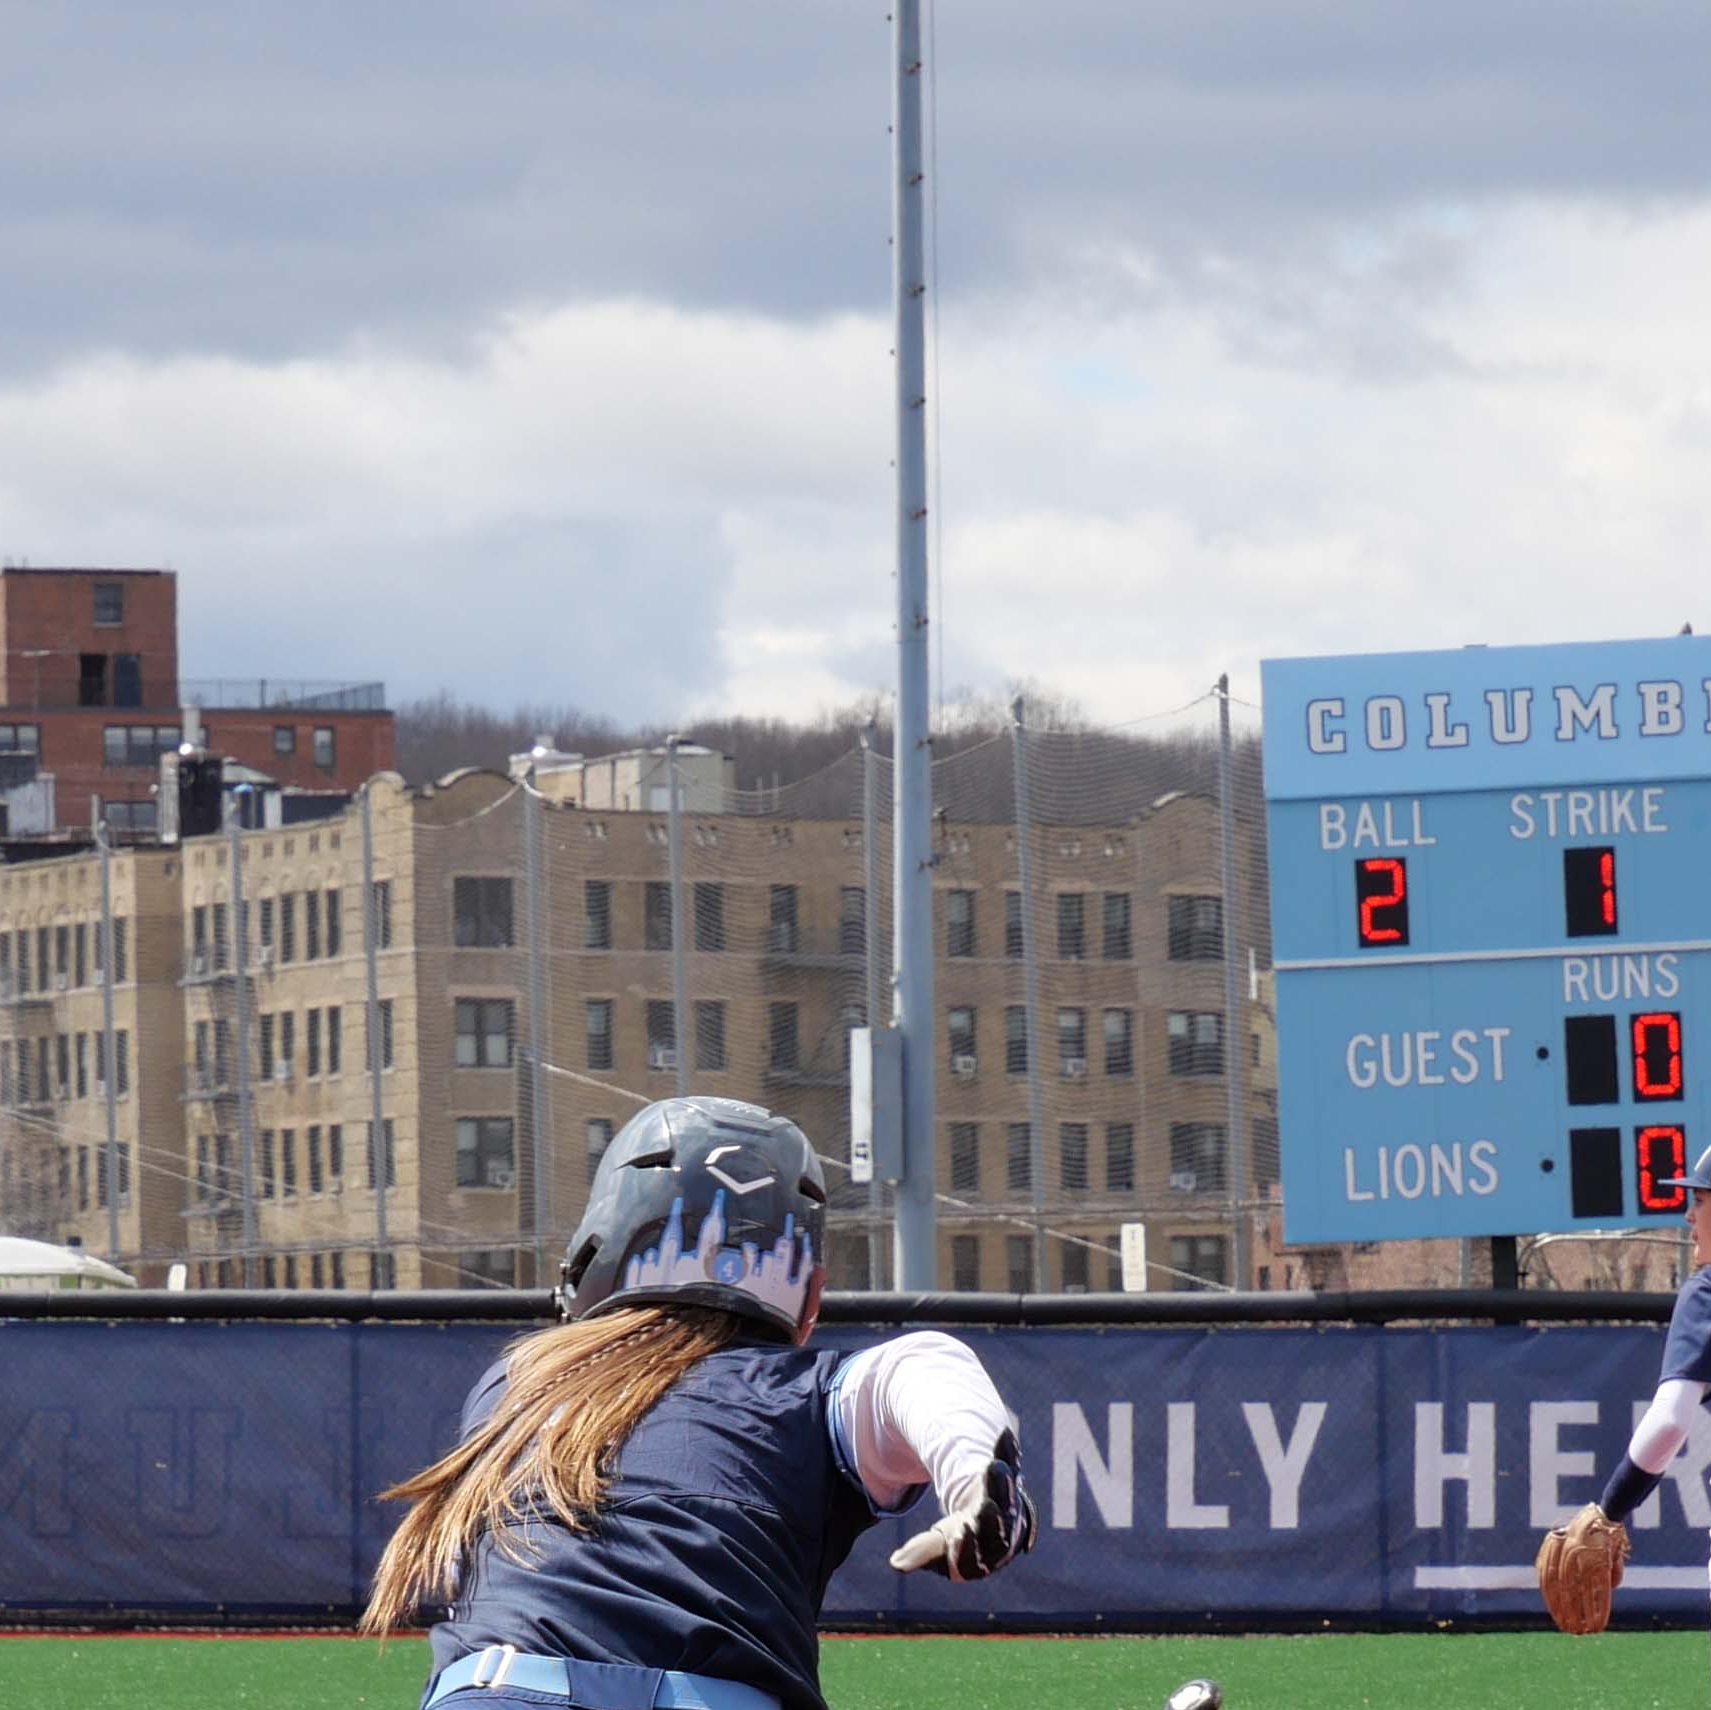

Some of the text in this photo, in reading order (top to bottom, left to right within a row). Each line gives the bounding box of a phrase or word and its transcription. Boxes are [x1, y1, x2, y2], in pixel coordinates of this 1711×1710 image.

[1320, 799, 1437, 850] BALL
[1509, 787, 1668, 839] STRIKE
[1361, 858, 1406, 942] 2
[1600, 851, 1617, 926] 1
[1563, 953, 1680, 1002] RUNS
[1346, 1027, 1512, 1089] GUEST
[1633, 1012, 1683, 1096] 0
[1345, 1140, 1499, 1201] LIONS
[1637, 1126, 1686, 1210] 0
[1006, 1401, 1329, 1529] NLY
